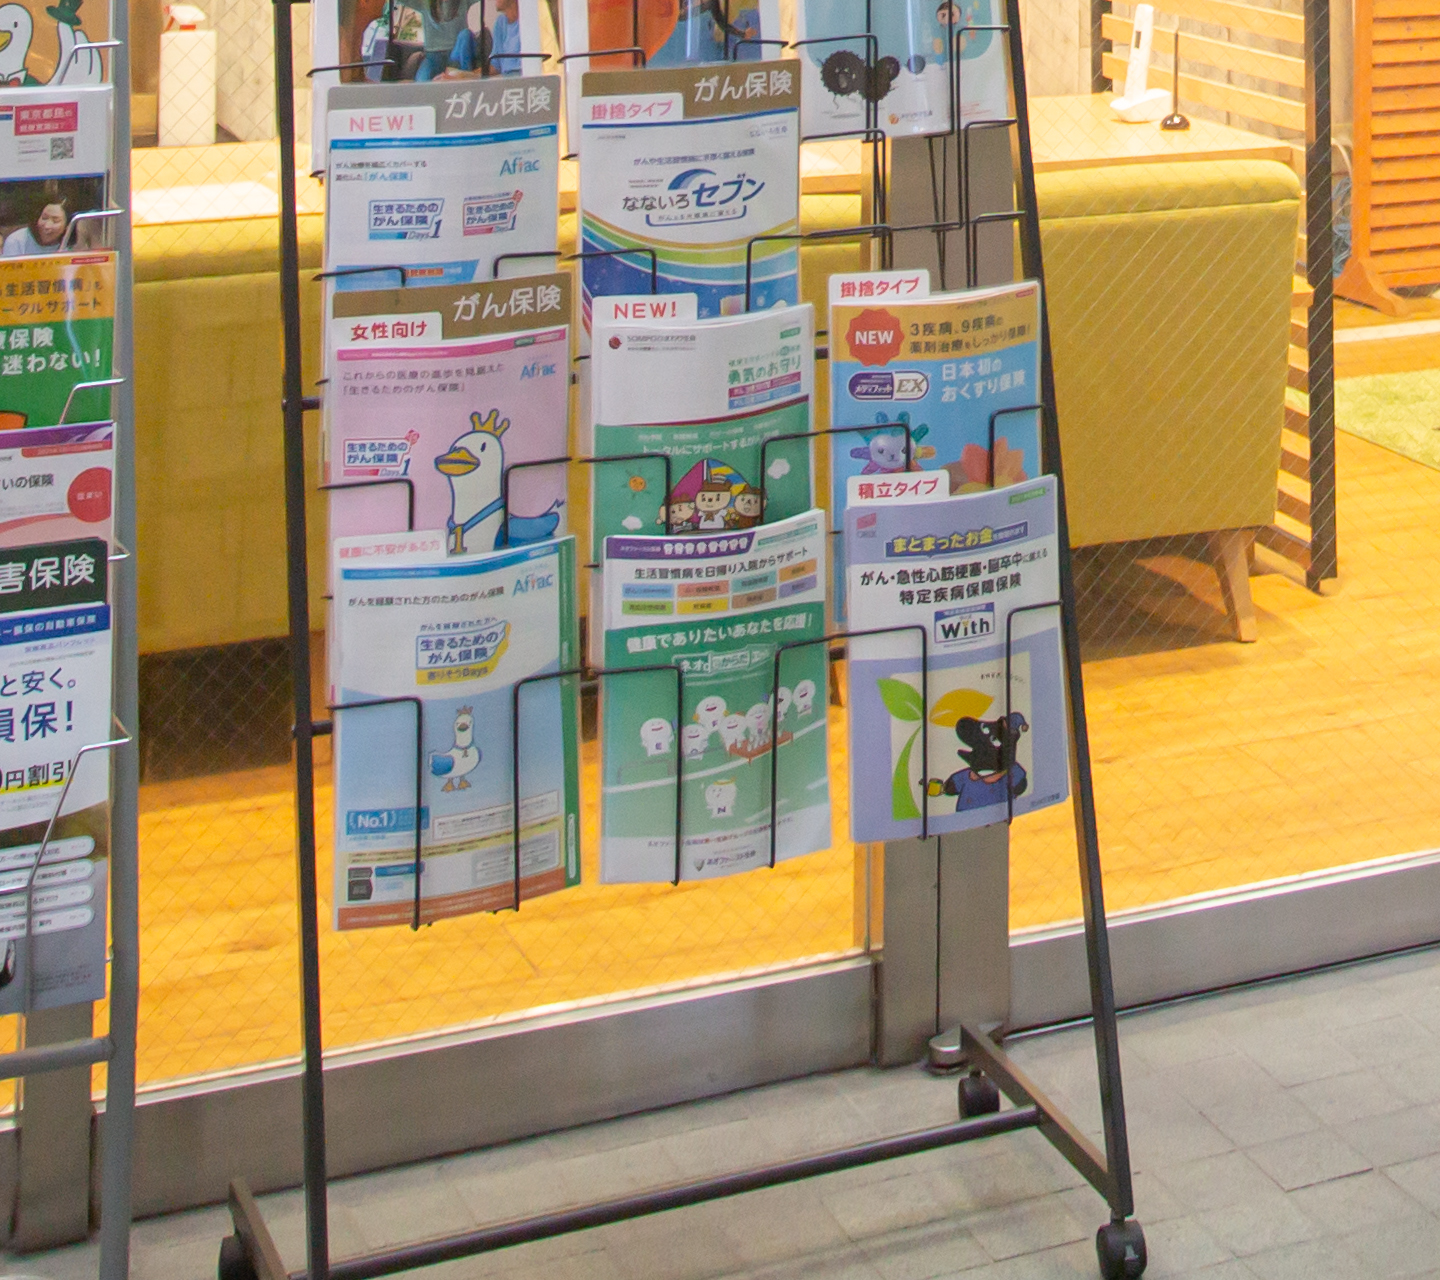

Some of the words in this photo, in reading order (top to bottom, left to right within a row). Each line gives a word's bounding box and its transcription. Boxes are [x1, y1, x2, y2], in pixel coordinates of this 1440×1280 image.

[694, 70, 793, 103] がん保険
[445, 86, 552, 118] がん保険
[349, 114, 414, 132] NEW!
[499, 158, 540, 177] Aflac
[373, 202, 439, 214] 生きるための
[373, 215, 429, 226] がん保険
[453, 285, 562, 322] がん保険
[614, 301, 677, 319] NEW!
[351, 321, 427, 341] 女性向け
[855, 330, 894, 345] NEW
[520, 363, 556, 381] Aflac
[858, 478, 938, 498] 積立タイプ
[512, 574, 553, 597] Aflac
[900, 573, 1022, 605] 特定疾病保障保険
[941, 618, 991, 640] With
[420, 632, 498, 652] 生きるための
[428, 647, 488, 665] がん保険
